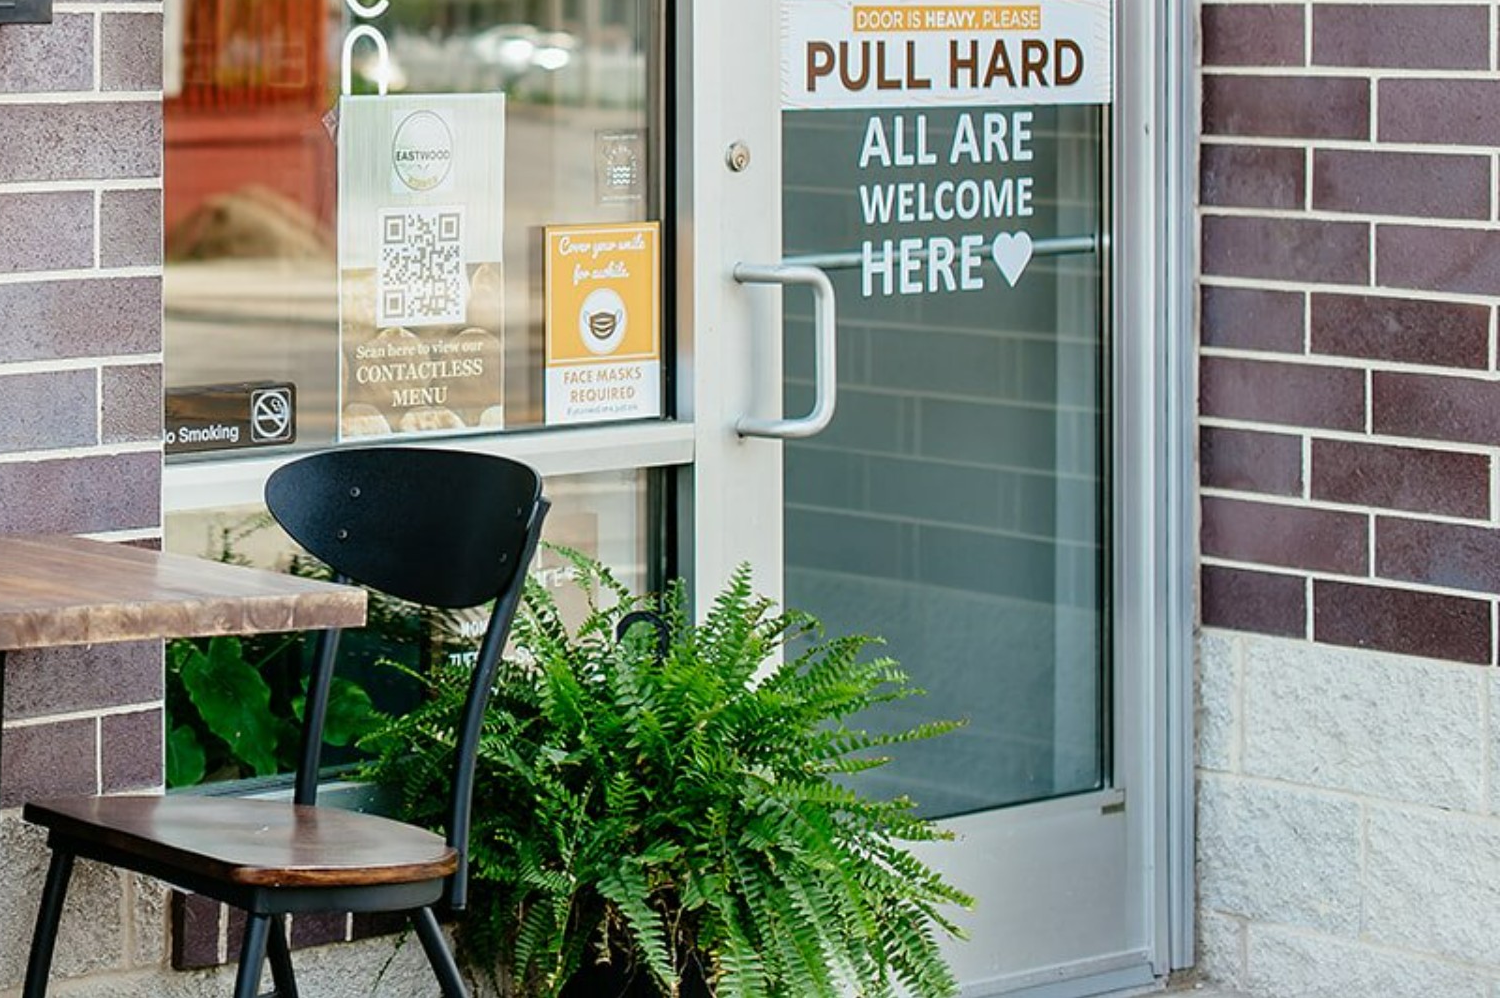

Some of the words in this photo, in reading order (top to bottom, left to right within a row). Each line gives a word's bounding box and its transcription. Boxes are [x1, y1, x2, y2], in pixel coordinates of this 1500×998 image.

[856, 10, 903, 29] DOOR
[907, 10, 921, 28] IS
[982, 9, 1039, 28] PLEASE
[806, 40, 932, 93] PULL
[949, 38, 1085, 89] HARD
[858, 114, 937, 168] ALL
[949, 111, 1034, 164] ARE
[396, 149, 450, 161] EASTWOOD
[858, 177, 1034, 225] WELCOME
[559, 235, 591, 256] Cover
[591, 240, 618, 259] your
[618, 231, 646, 250] smile
[573, 263, 590, 286] for
[861, 233, 984, 298] HERE
[356, 345, 385, 360] Scan
[387, 344, 416, 356] here
[417, 343, 430, 355] to
[431, 340, 459, 353] view
[461, 342, 484, 352] our
[356, 359, 483, 384] CONTACTLESS
[563, 370, 594, 384] FACE
[596, 366, 642, 382] MASKS
[391, 386, 448, 407] MENU
[570, 386, 636, 403] REQUIRED
[163, 428, 176, 444] o
[179, 424, 239, 443] Smoking
